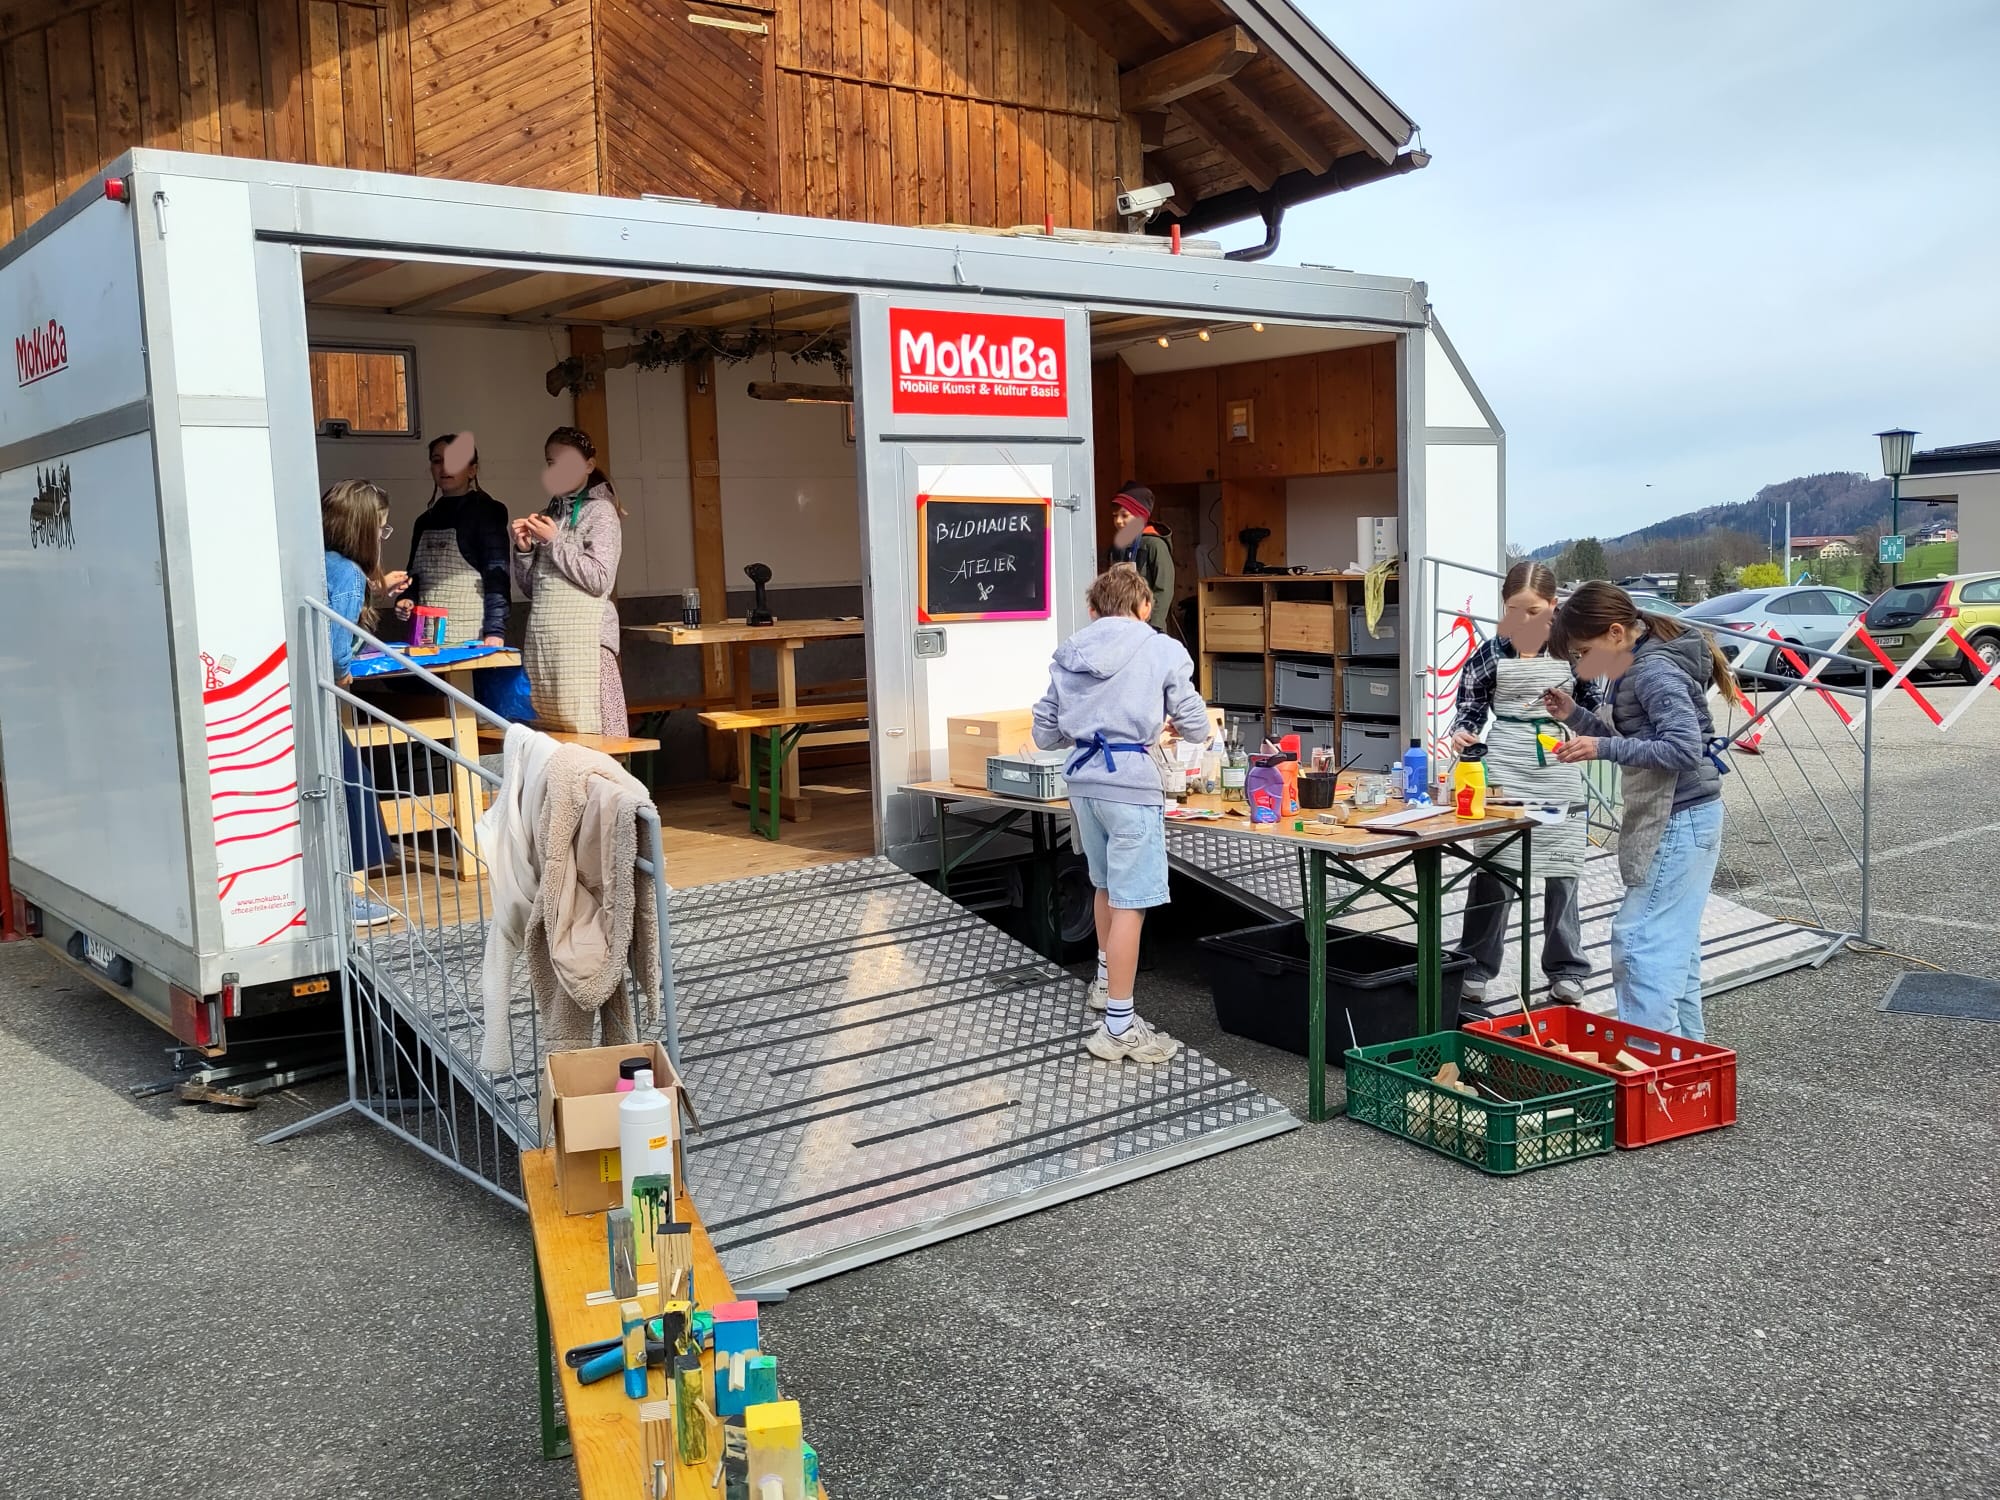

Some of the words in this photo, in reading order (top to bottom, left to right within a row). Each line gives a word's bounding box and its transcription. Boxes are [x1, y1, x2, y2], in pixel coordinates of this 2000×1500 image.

[15, 318, 68, 383] MoKuBa
[899, 328, 1058, 381] MoKuBa
[900, 380, 939, 393] Mobile
[943, 382, 976, 394] Kunst
[979, 383, 991, 395] &
[994, 385, 1028, 396] Kultur
[1030, 386, 1060, 397] Basis
[947, 554, 1017, 583] ATELIER
